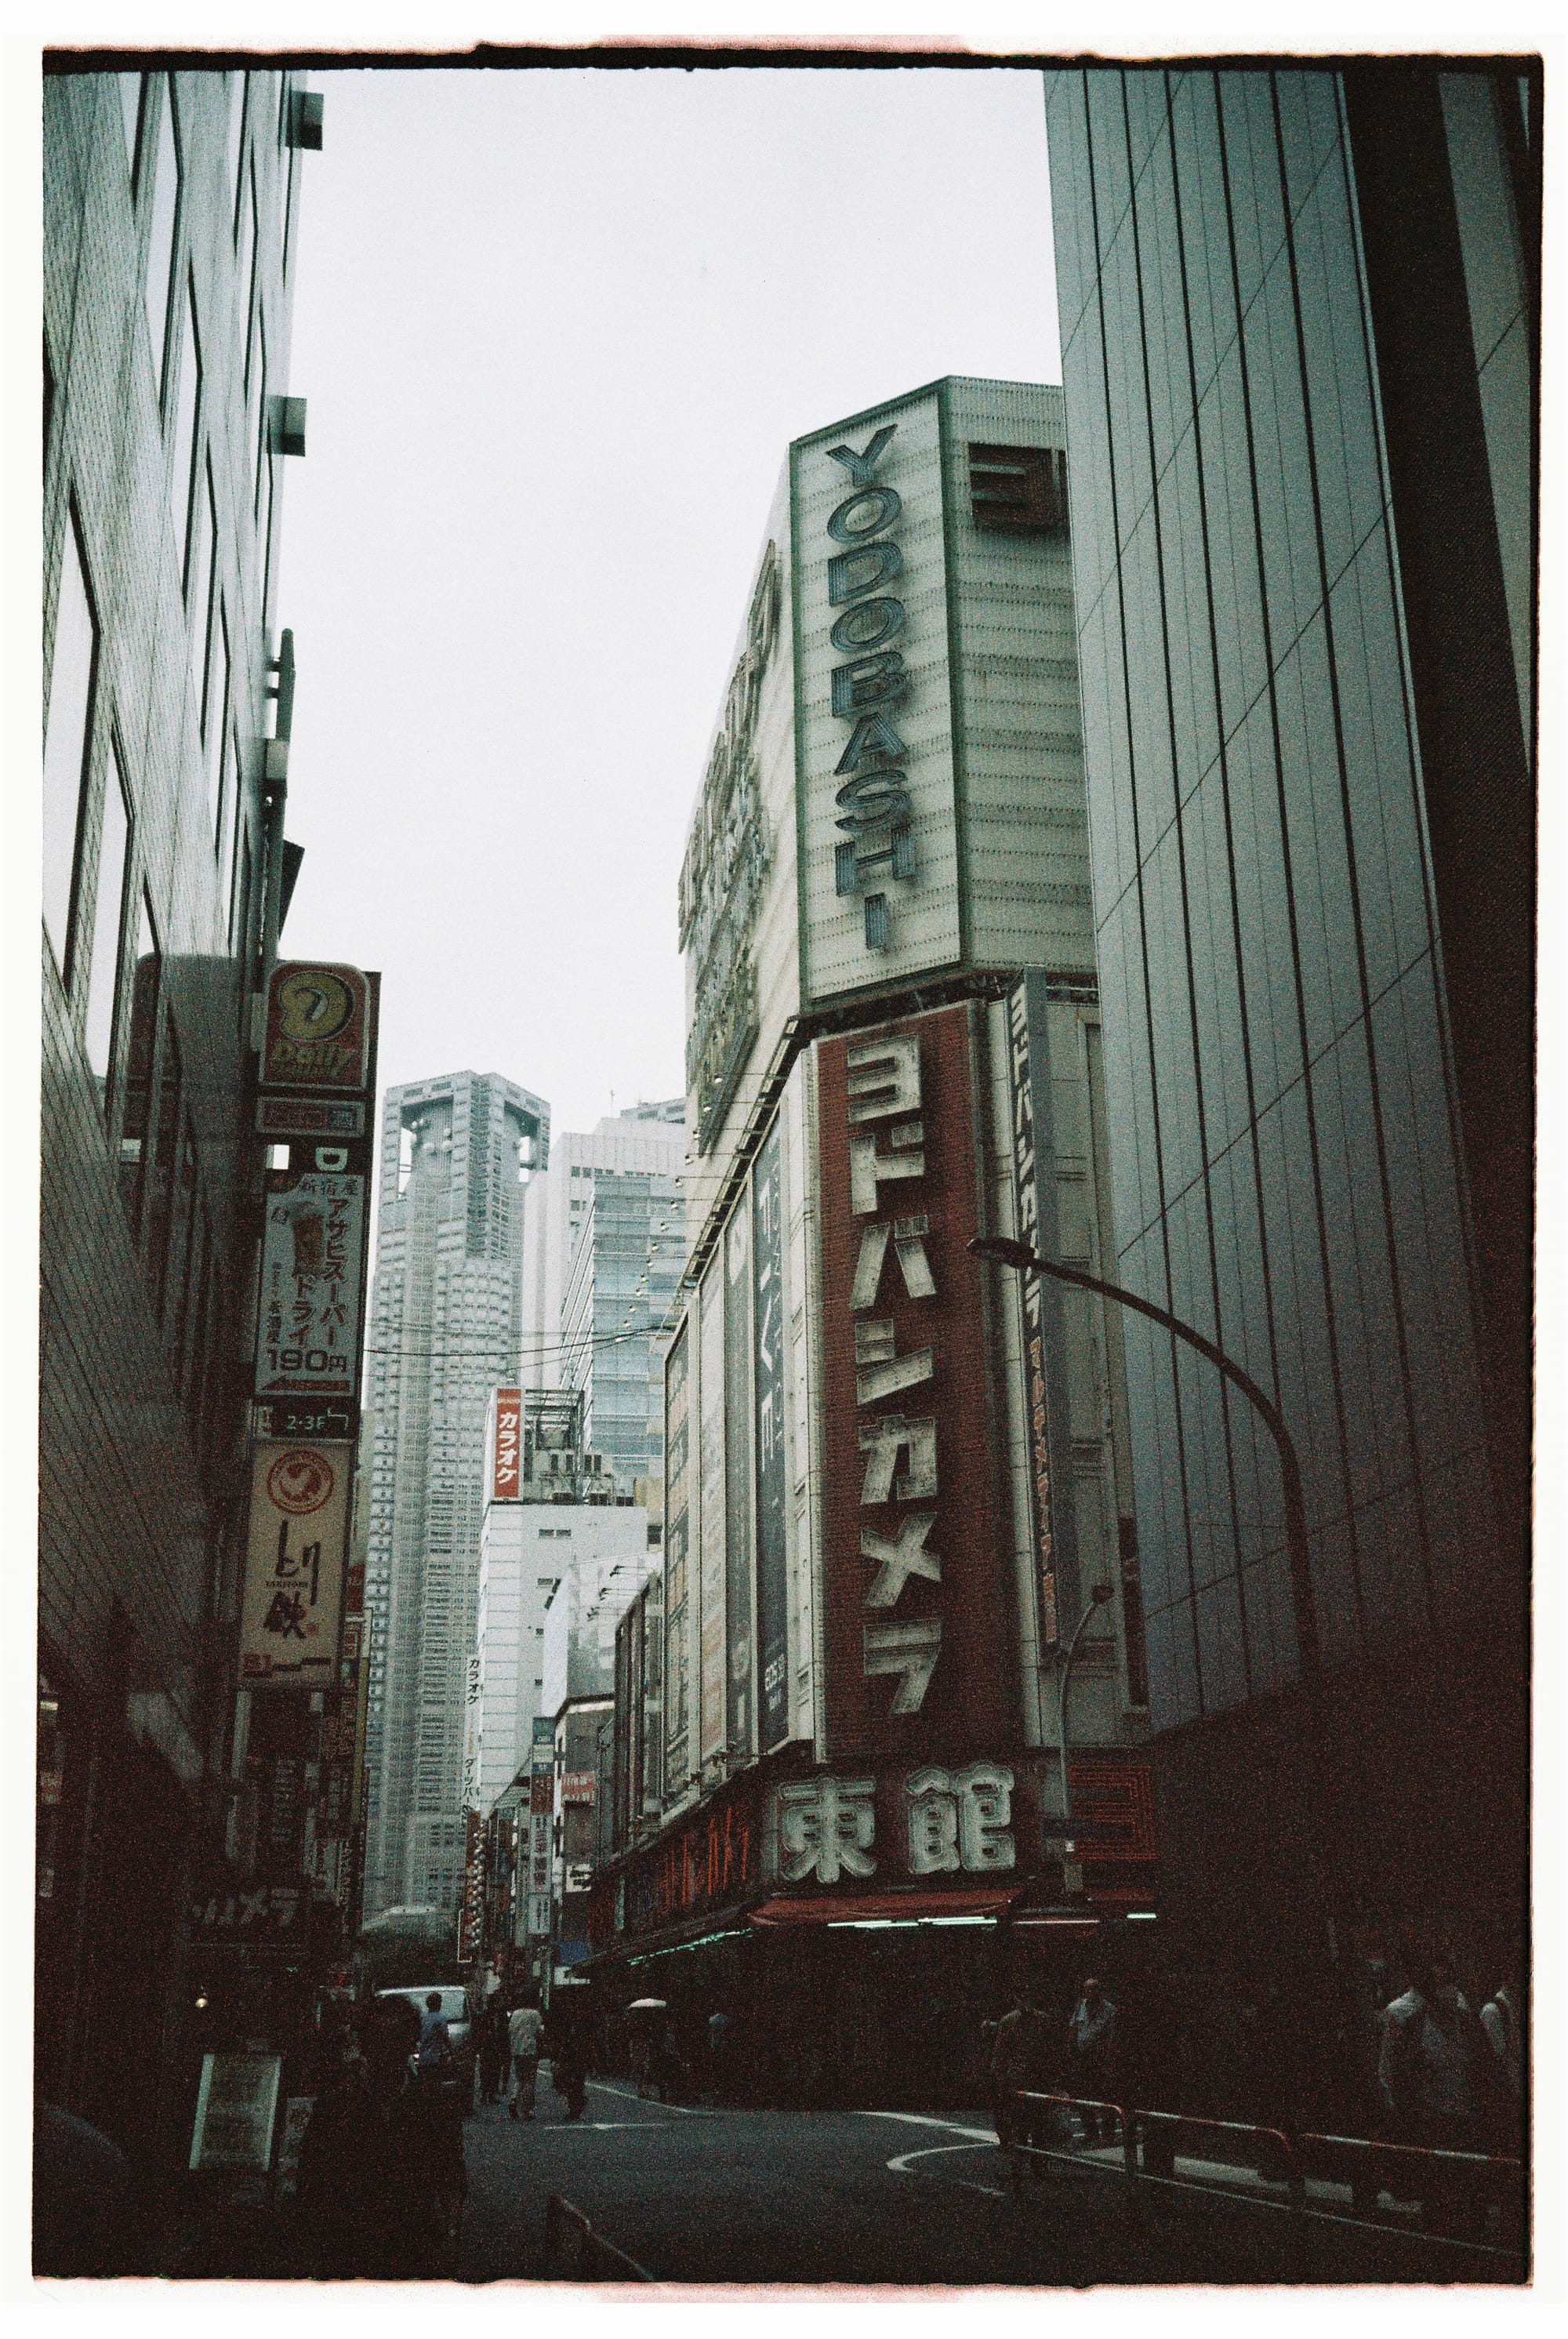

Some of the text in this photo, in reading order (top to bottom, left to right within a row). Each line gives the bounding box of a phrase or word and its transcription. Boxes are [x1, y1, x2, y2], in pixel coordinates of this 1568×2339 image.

[968, 442, 1069, 535] ヨ
[826, 423, 917, 950] YODOBASHI
[289, 1275, 316, 1346] ドライ
[321, 1198, 349, 1346] アサヒスーパー
[267, 1349, 347, 1372] 190円
[847, 1031, 944, 1715] ヨドバシカメラ
[496, 1411, 518, 1484] カラオケ
[467, 1658, 479, 1705] カラオケ
[781, 1764, 1016, 1885] 東館
